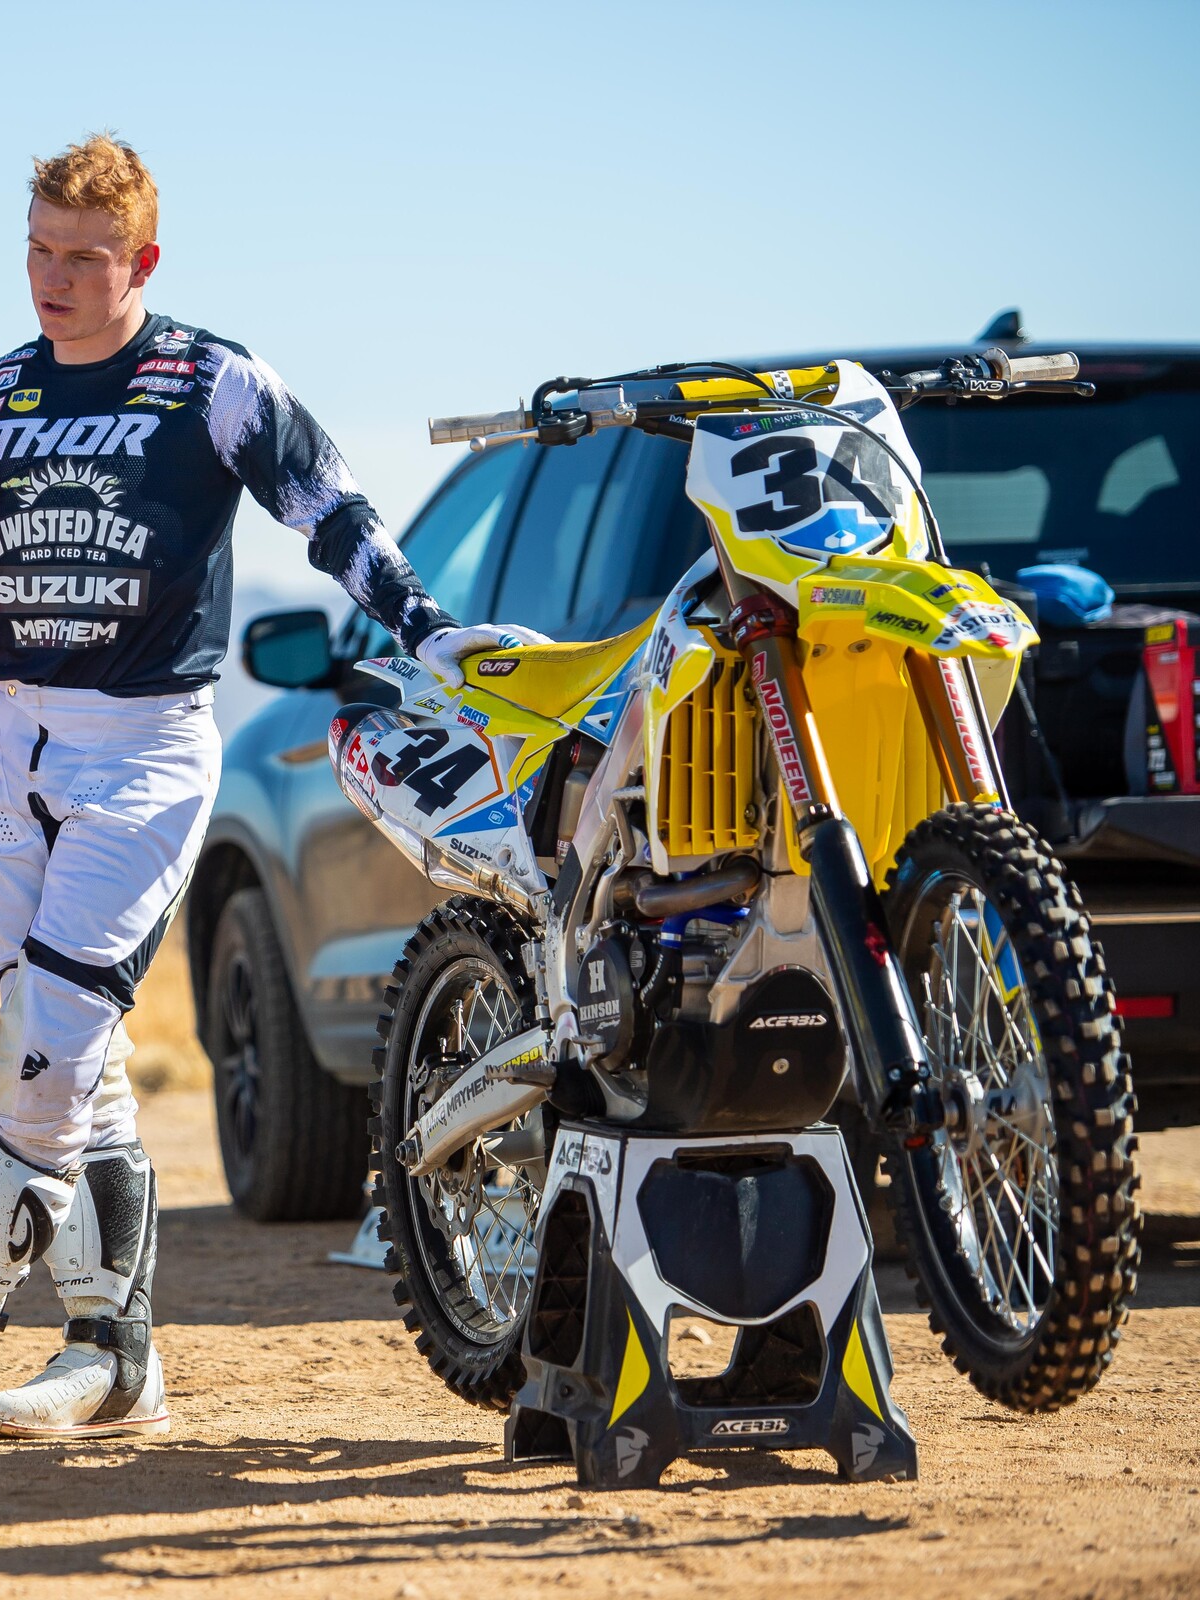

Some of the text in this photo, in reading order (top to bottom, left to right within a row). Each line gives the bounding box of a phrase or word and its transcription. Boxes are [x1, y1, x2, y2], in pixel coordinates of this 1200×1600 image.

[12, 391, 39, 403] WD-40
[970, 380, 1004, 392] WC
[731, 429, 905, 532] 34
[95, 509, 149, 560] TEA
[22, 548, 106, 562] HARD ICED TEA
[11, 619, 119, 642] MAYHEM
[872, 611, 930, 636] MAYHEM
[388, 658, 421, 681] SUZUKI
[479, 660, 516, 673] GUTS
[459, 705, 490, 726] PARTS
[761, 679, 809, 801] NOLEEN
[371, 729, 491, 817] 34
[580, 1000, 620, 1021] HINSON
[749, 1014, 827, 1028] ACERBIS
[446, 1075, 494, 1117] MAYHEM
[54, 1276, 94, 1288] orma
